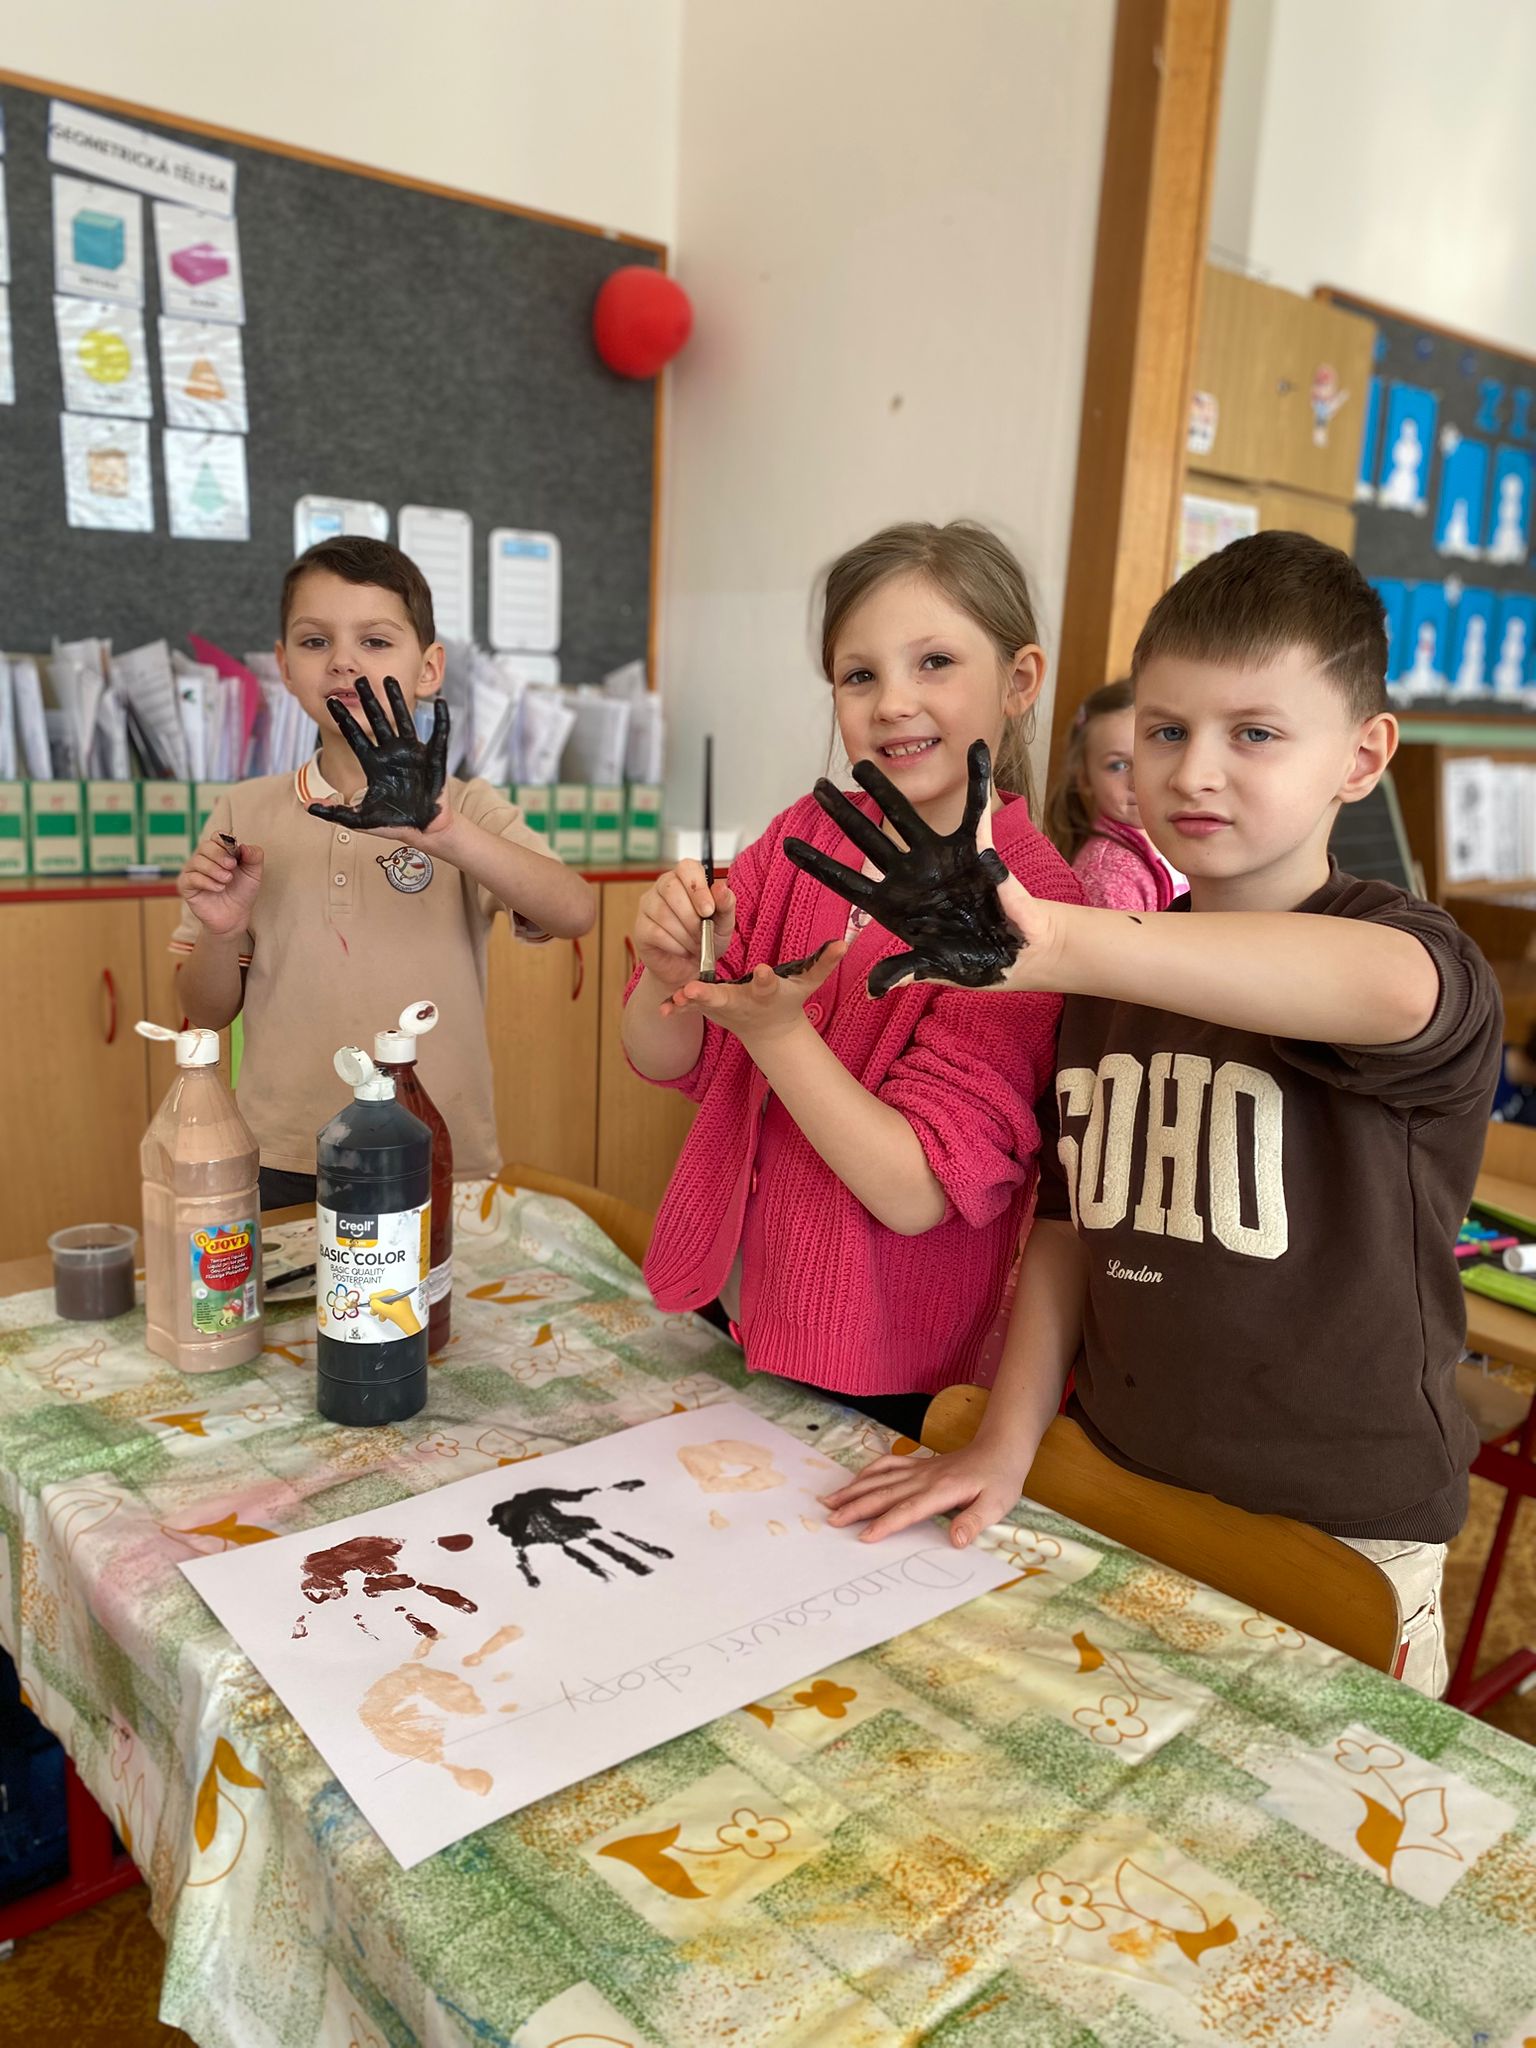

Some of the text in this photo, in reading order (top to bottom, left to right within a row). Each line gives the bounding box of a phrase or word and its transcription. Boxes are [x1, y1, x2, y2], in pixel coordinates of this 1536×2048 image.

[1056, 1052, 1288, 1260] SOHO
[339, 1219, 371, 1231] Creall
[210, 1235, 246, 1251] JOVI
[319, 1244, 406, 1266] BASIC COLOR
[330, 1264, 386, 1276] BASIC QUALITY
[1106, 1259, 1163, 1283] London
[332, 1273, 382, 1285] POSTERPAINT
